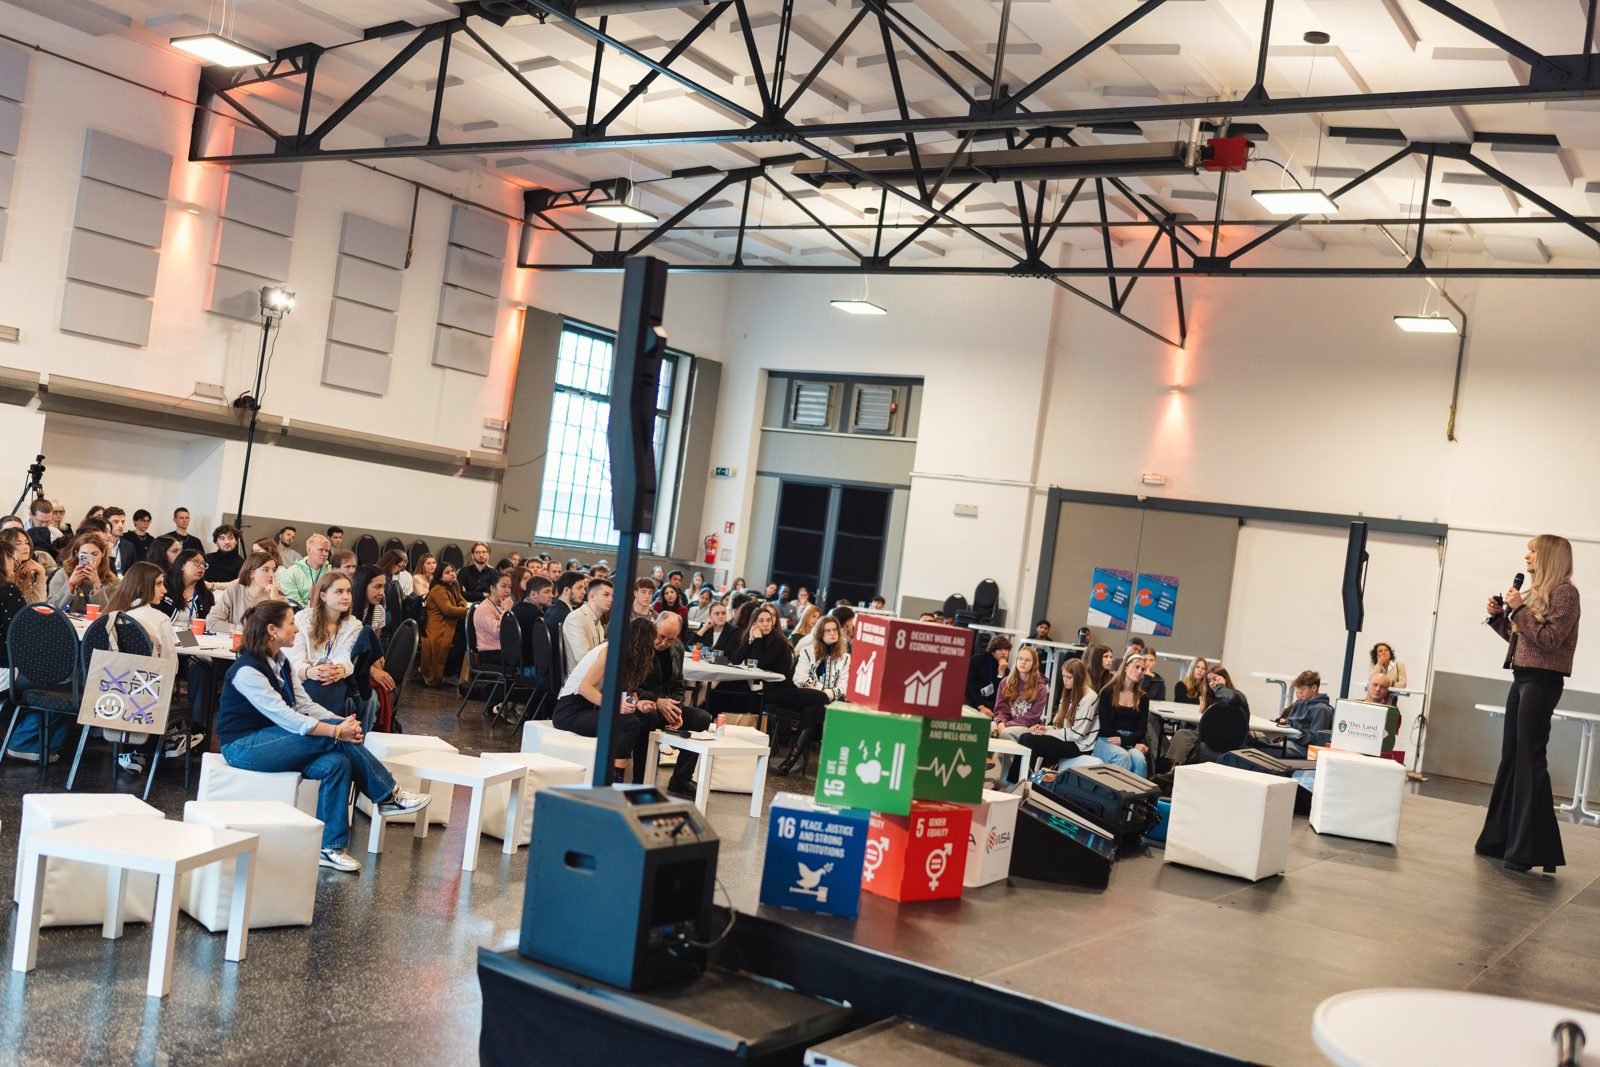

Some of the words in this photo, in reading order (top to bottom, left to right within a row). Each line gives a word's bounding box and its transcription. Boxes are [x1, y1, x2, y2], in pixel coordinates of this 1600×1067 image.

[895, 629, 907, 650] 8
[911, 631, 934, 642] DECENT
[934, 634, 952, 644] WORK
[952, 636, 966, 646] AND
[909, 642, 939, 654] ECONOMIC
[939, 645, 965, 657] GROWTH
[931, 720, 948, 729] GOOD
[948, 722, 971, 731] HEALTH
[929, 730, 942, 739] AND
[942, 732, 977, 742] WELL-BEING
[1347, 729, 1376, 738] Steiermark
[839, 746, 850, 763] LAND
[826, 760, 836, 775] LIFE
[838, 763, 846, 776] ON
[824, 778, 845, 796] 15
[777, 815, 796, 839] 16
[915, 817, 925, 838] 5
[928, 817, 947, 826] GENDER
[825, 823, 854, 836] JUSTICE
[927, 828, 948, 838] EQUALITY
[799, 831, 814, 842] AND
[814, 833, 843, 846] STRONG
[797, 842, 845, 859] INSTITUTIONS
